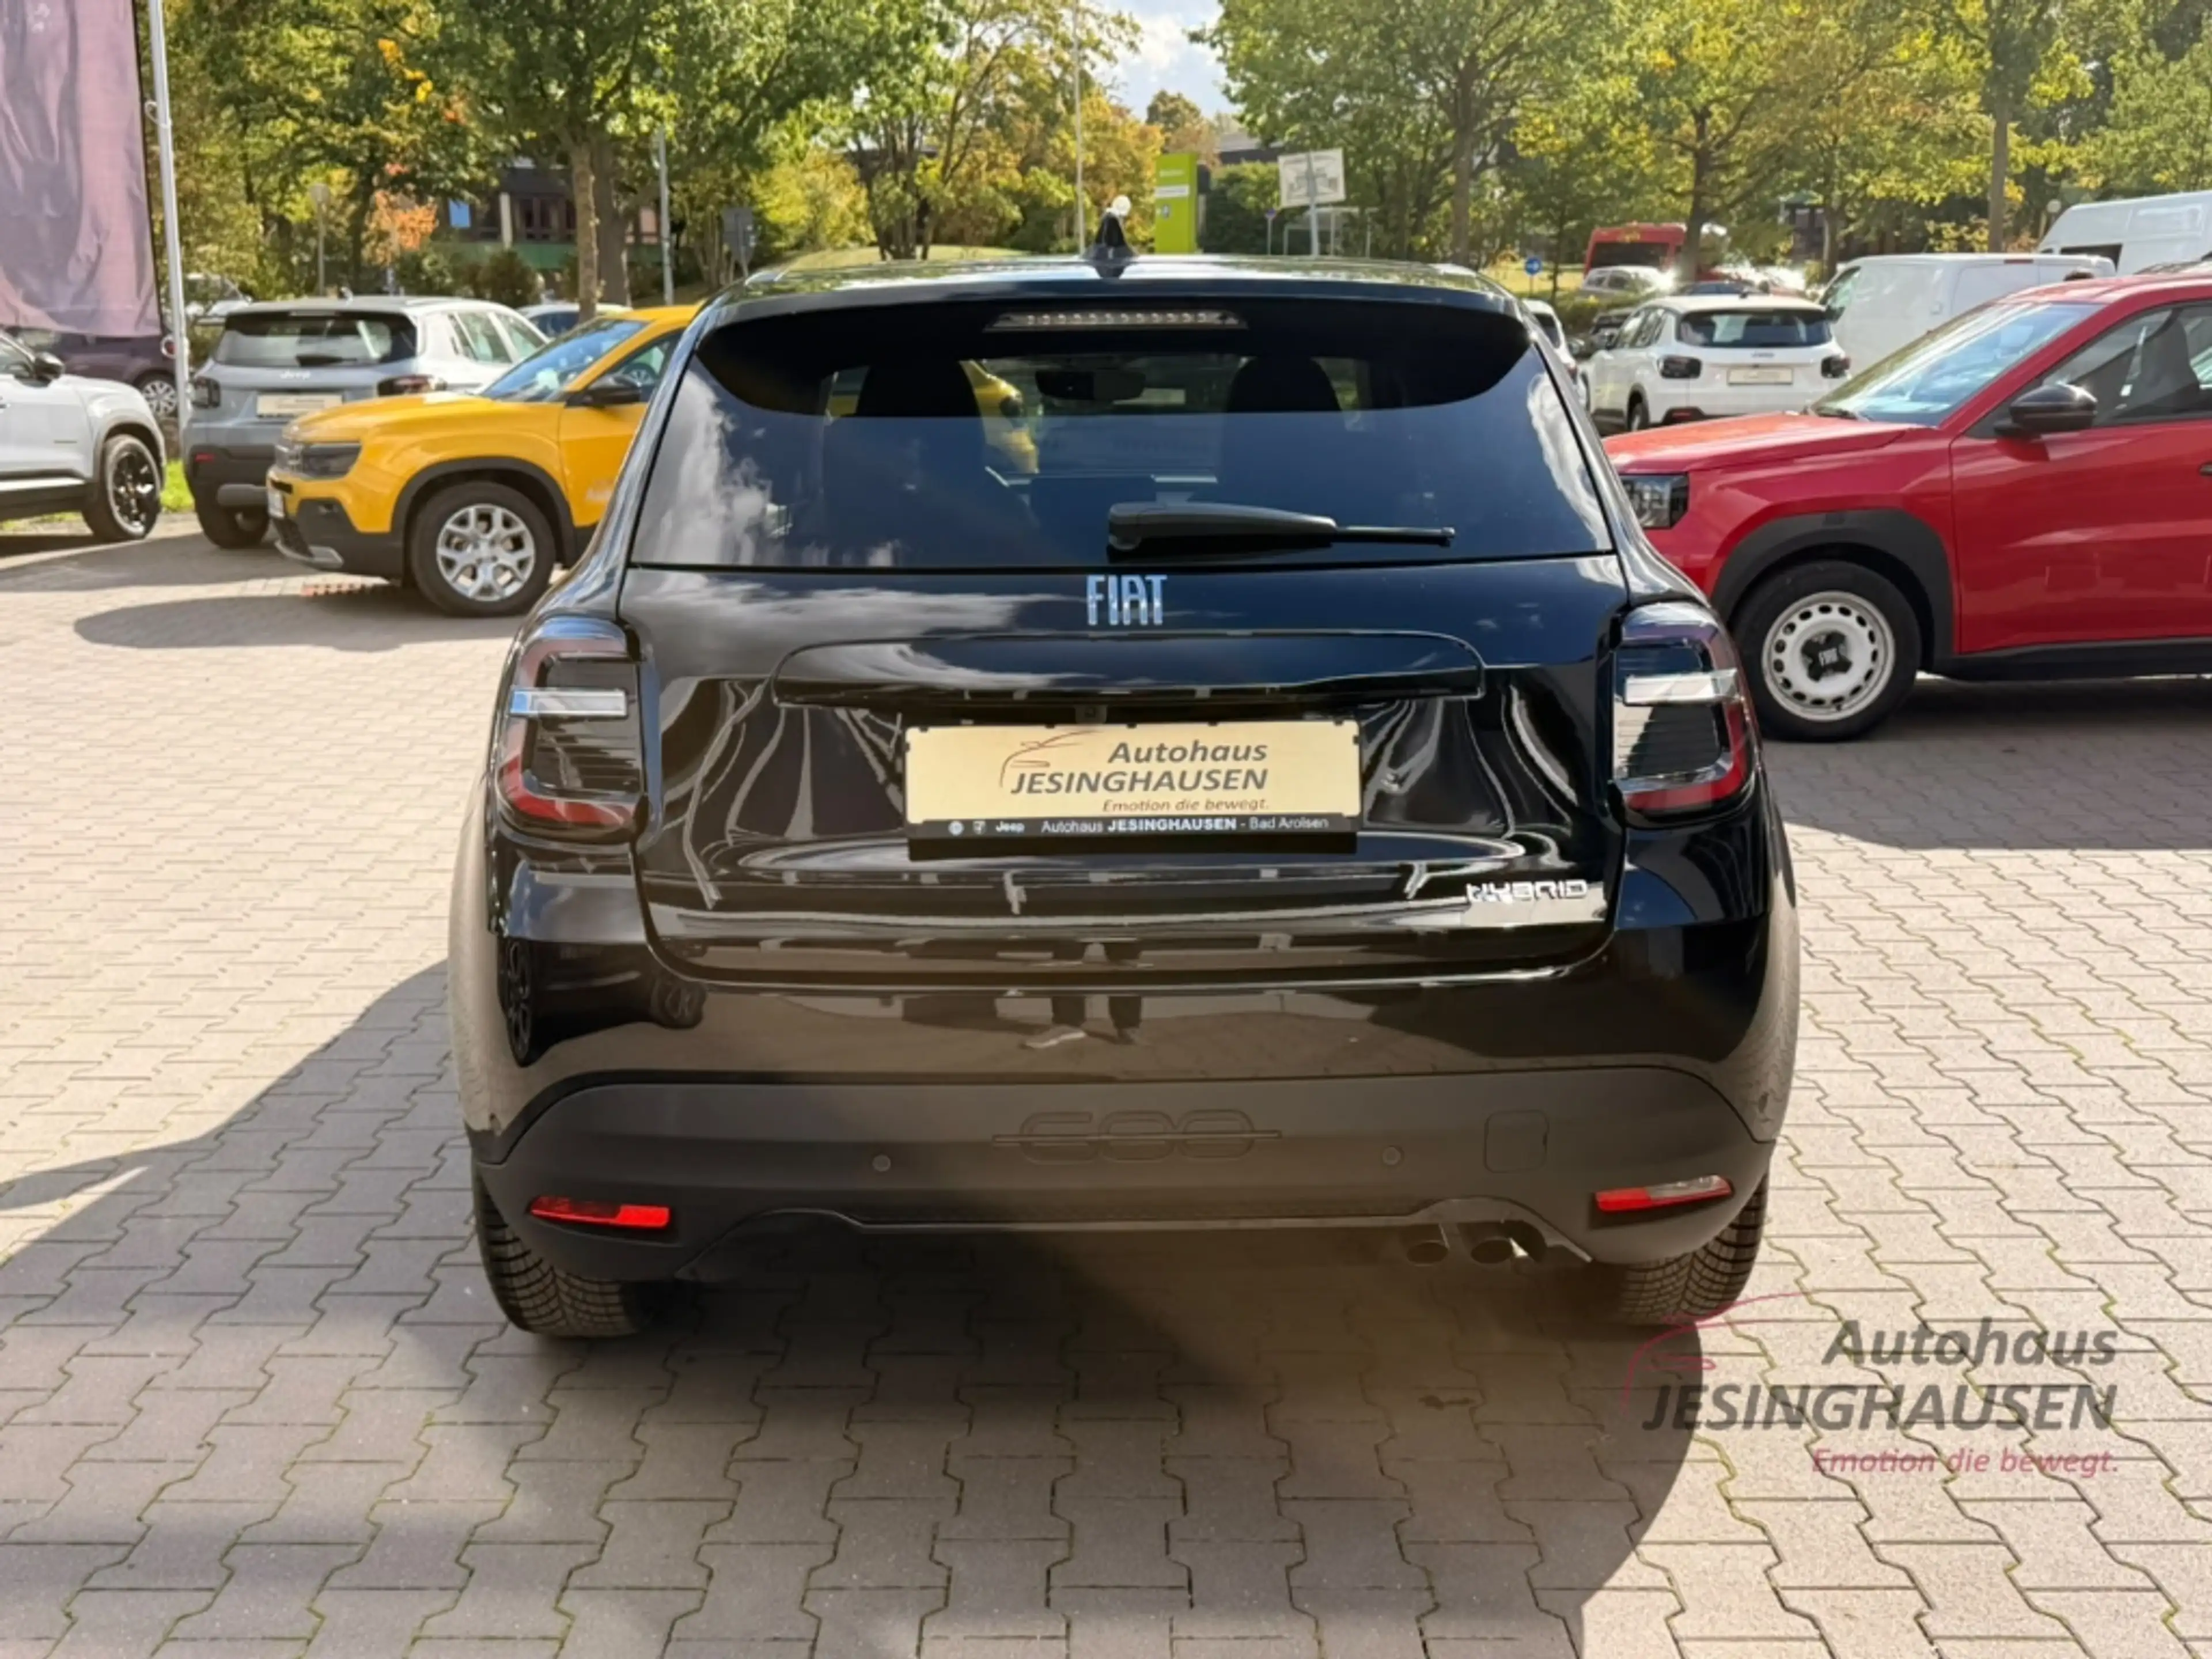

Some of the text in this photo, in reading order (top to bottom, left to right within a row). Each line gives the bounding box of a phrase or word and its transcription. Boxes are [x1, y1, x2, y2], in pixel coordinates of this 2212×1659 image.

[1086, 574, 1168, 626] FIAT
[1107, 740, 1268, 764] Autohaus
[1010, 769, 1268, 794] JESINGHAUSEN
[1103, 798, 1270, 813] Emotion die bewegt.
[995, 816, 1025, 833] Jeep
[1041, 815, 1103, 833] Autohaus
[1107, 817, 1237, 832] JESINGHAUSEN
[1249, 817, 1275, 830] Bad
[1278, 816, 1330, 829] Arolsen
[1467, 880, 1589, 903] HYBRID
